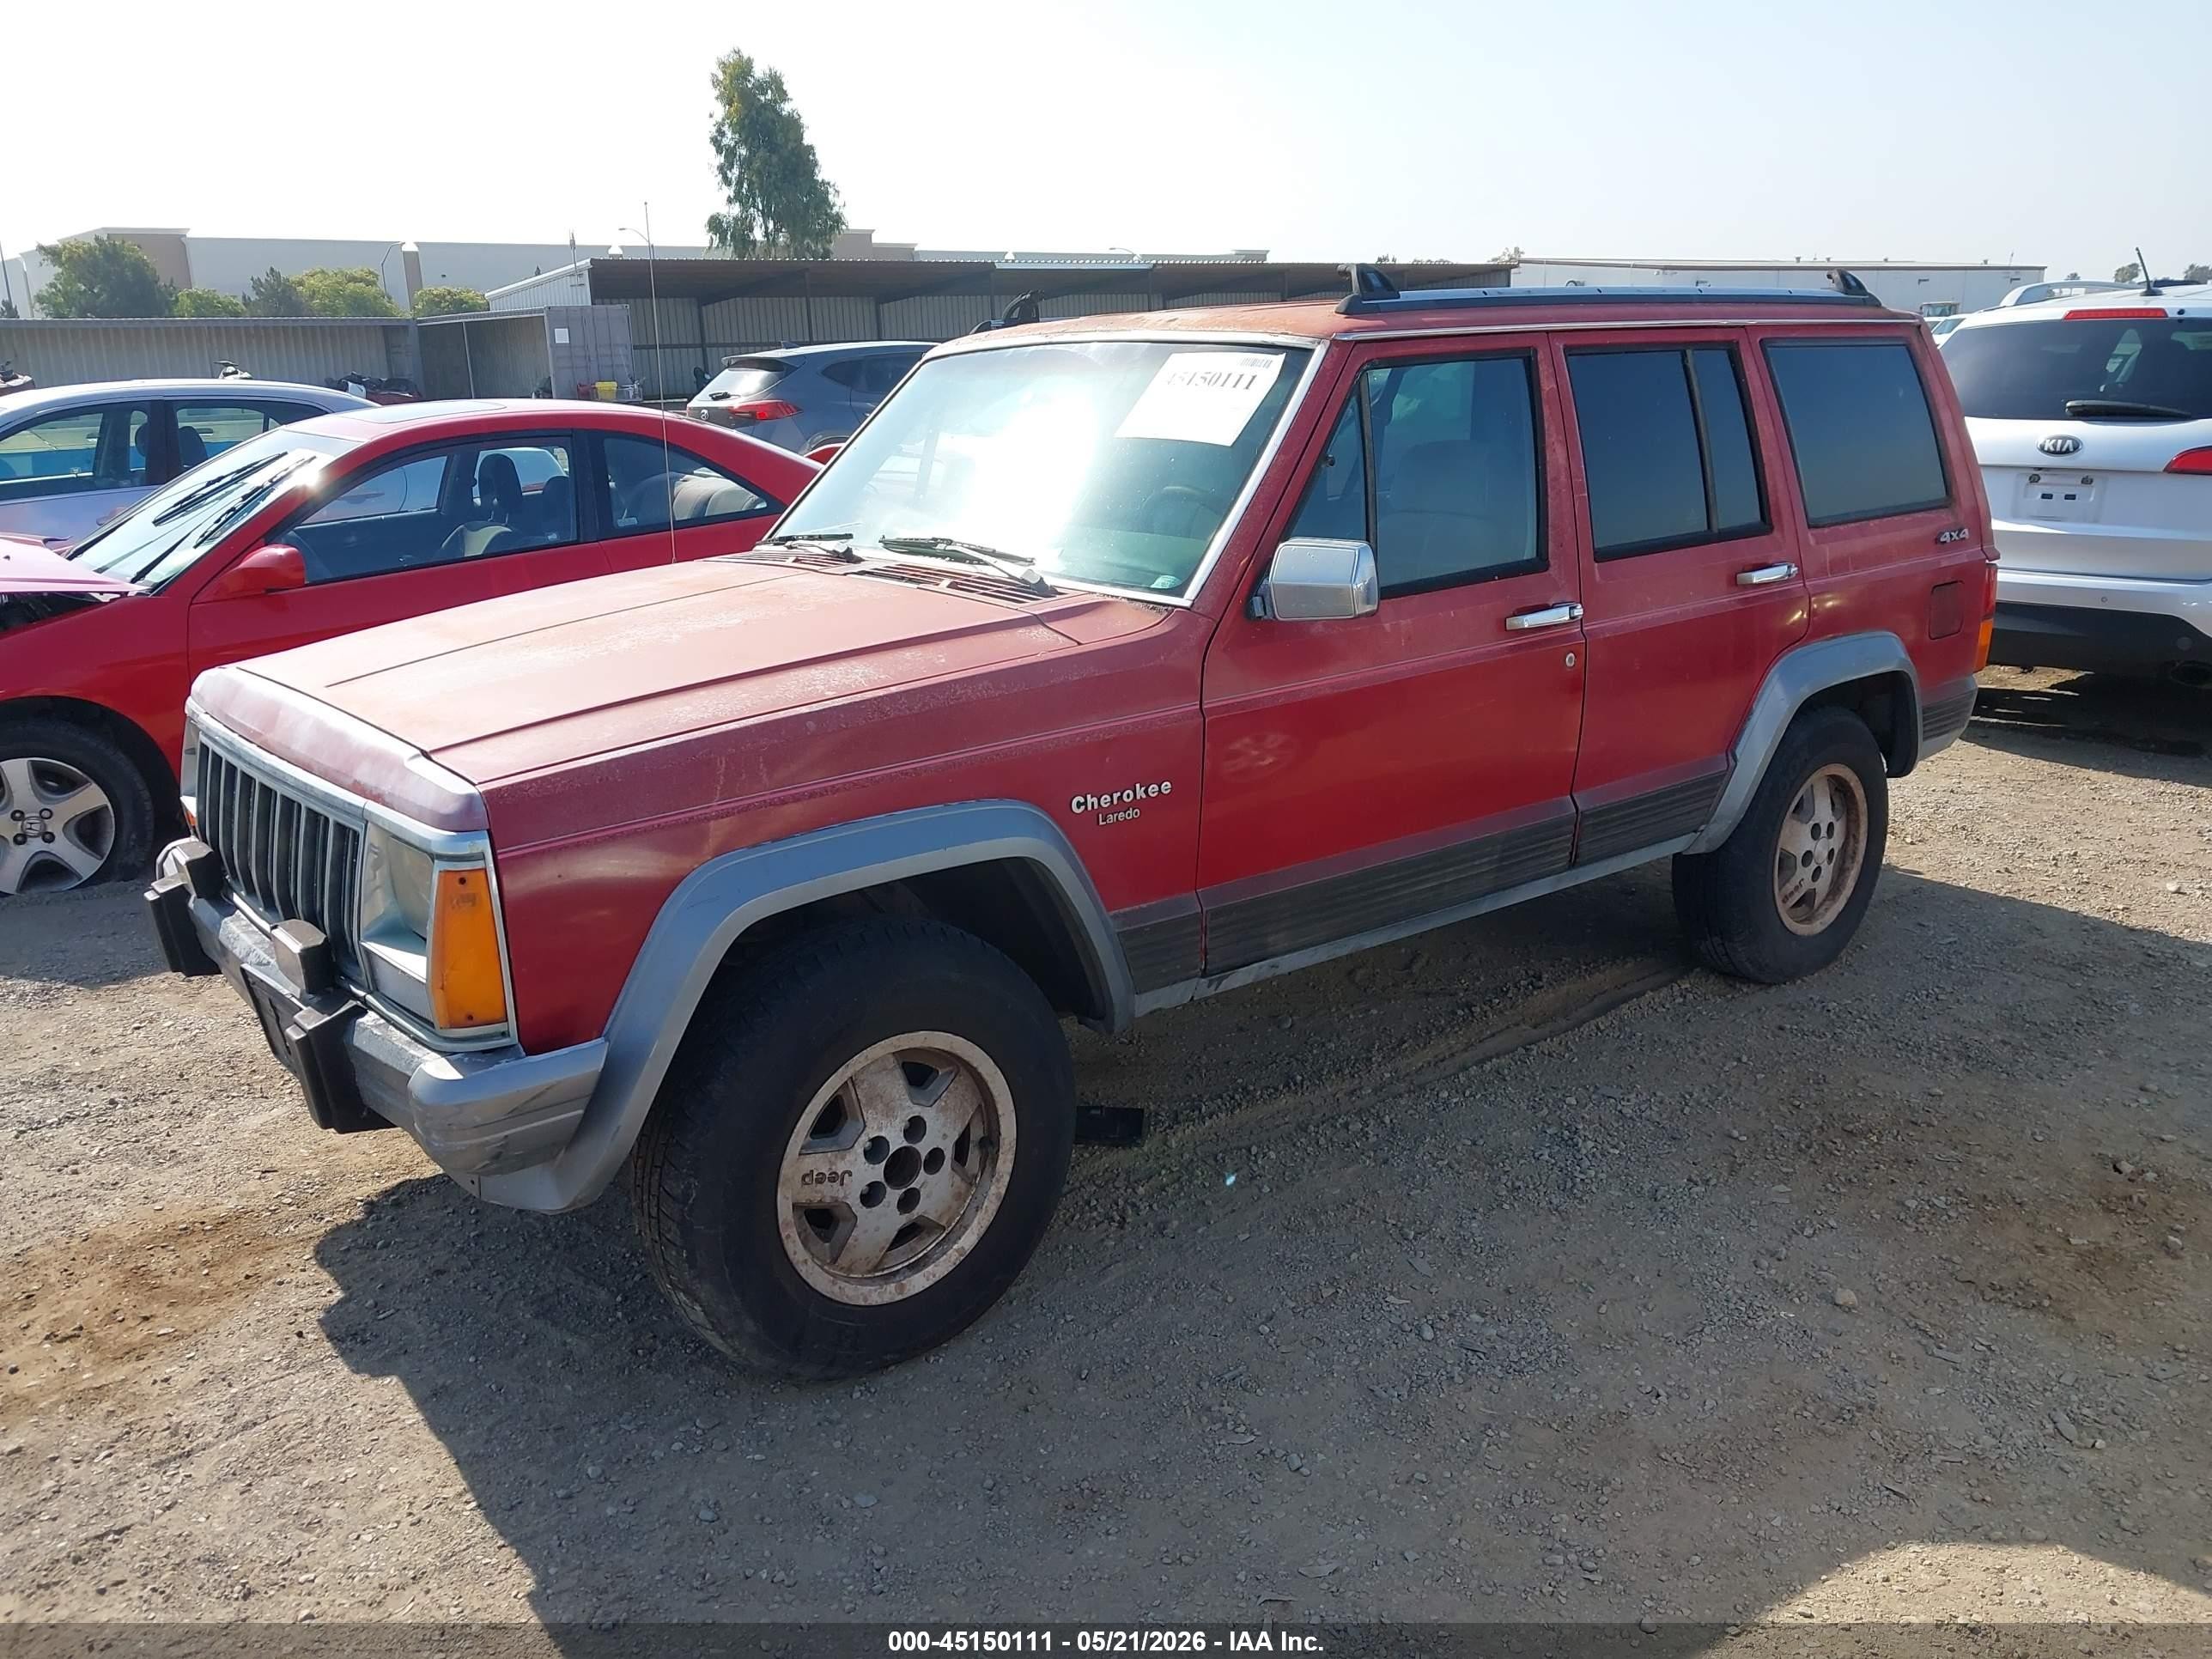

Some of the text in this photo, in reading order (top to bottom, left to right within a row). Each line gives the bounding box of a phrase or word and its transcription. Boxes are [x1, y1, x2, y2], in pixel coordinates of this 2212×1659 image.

[2044, 439, 2075, 453] KIA
[1071, 780, 1173, 814] Cherokee
[1098, 807, 1140, 825] Laredo
[801, 1169, 853, 1186] Jeep
